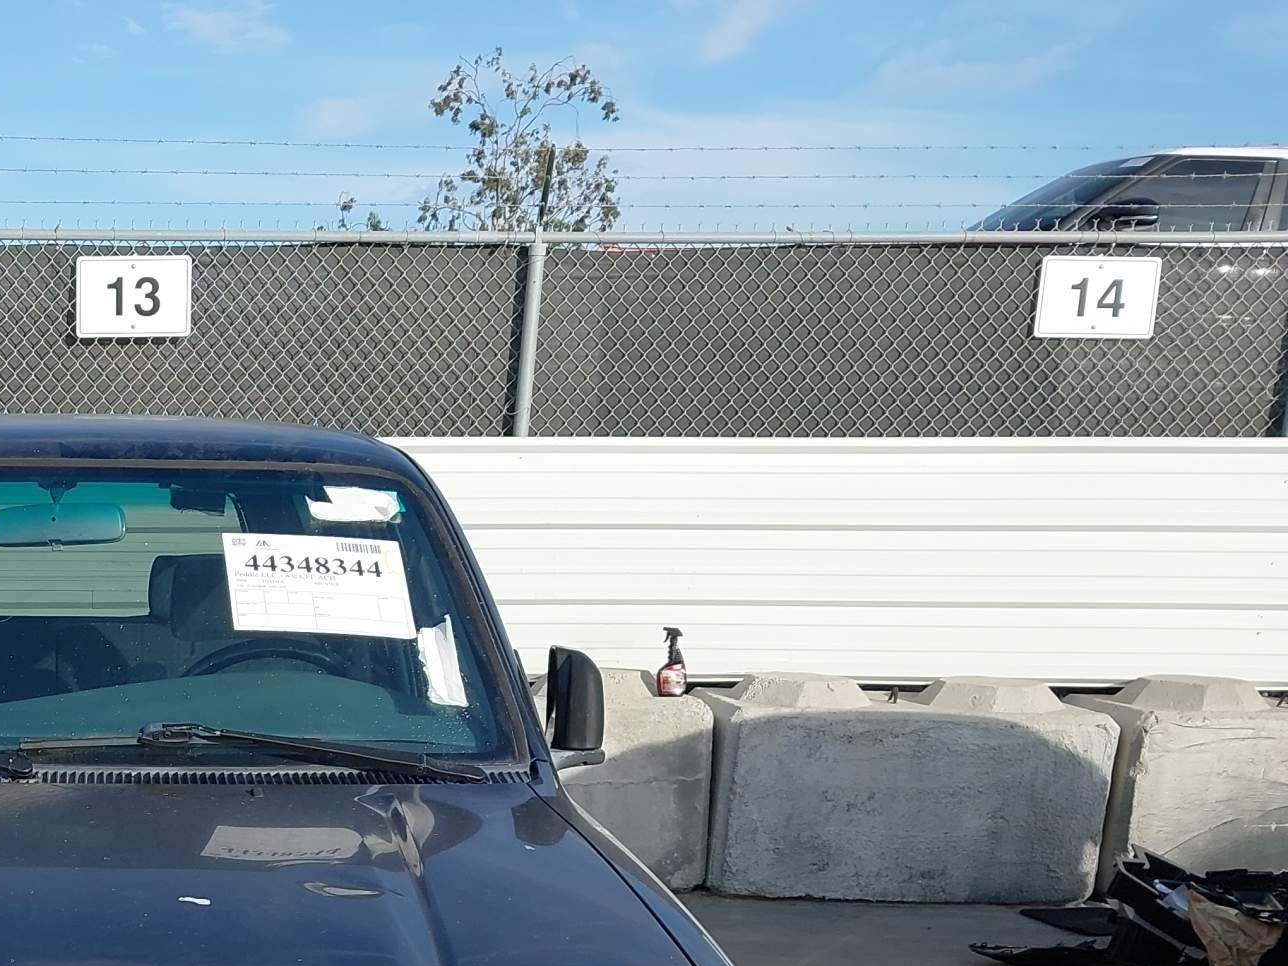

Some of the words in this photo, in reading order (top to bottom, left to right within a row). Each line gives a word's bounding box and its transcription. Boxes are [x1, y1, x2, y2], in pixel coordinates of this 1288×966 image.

[107, 277, 161, 317] 13
[1071, 277, 1125, 317] 14
[244, 554, 383, 578] 44348344
